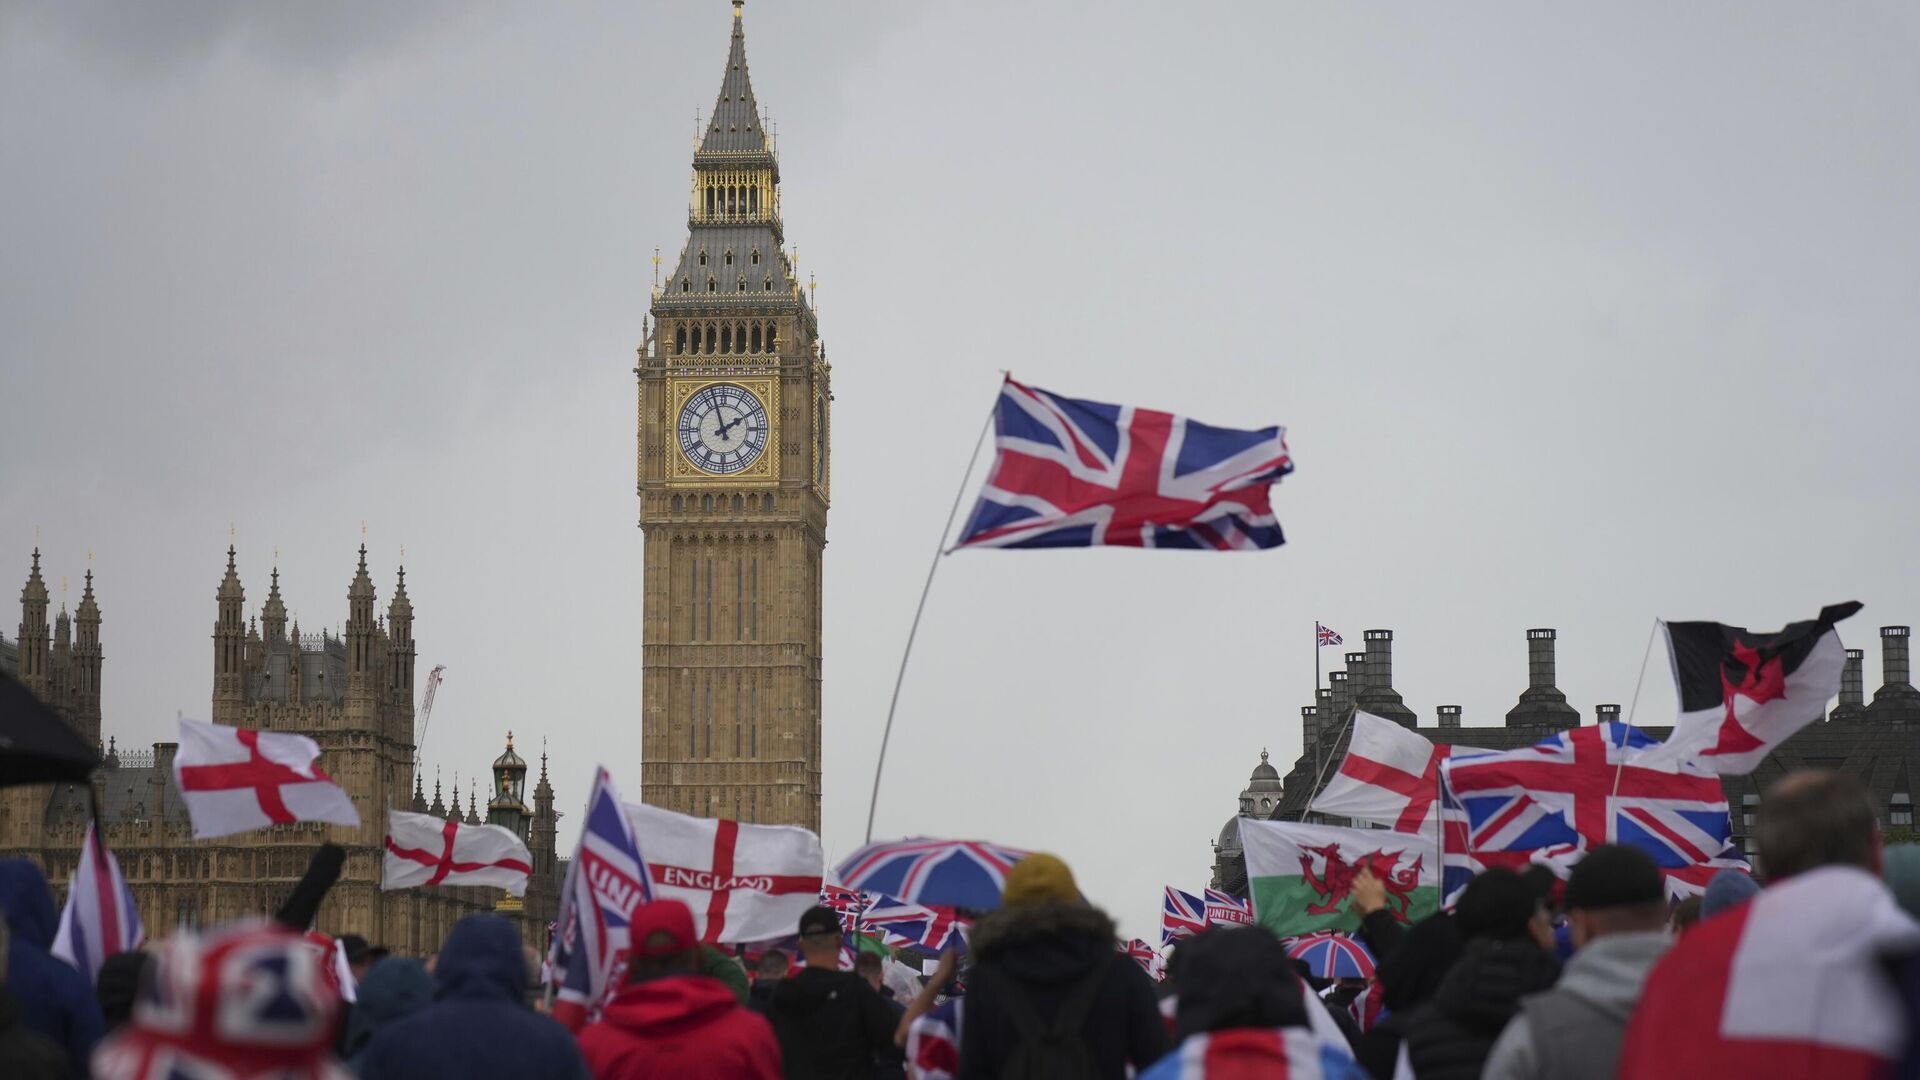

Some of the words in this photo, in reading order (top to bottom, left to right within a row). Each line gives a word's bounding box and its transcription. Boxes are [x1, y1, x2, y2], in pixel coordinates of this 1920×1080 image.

[588, 860, 644, 920] UNI
[663, 867, 773, 893] ENGLAND
[1208, 908, 1237, 921] UNITE
